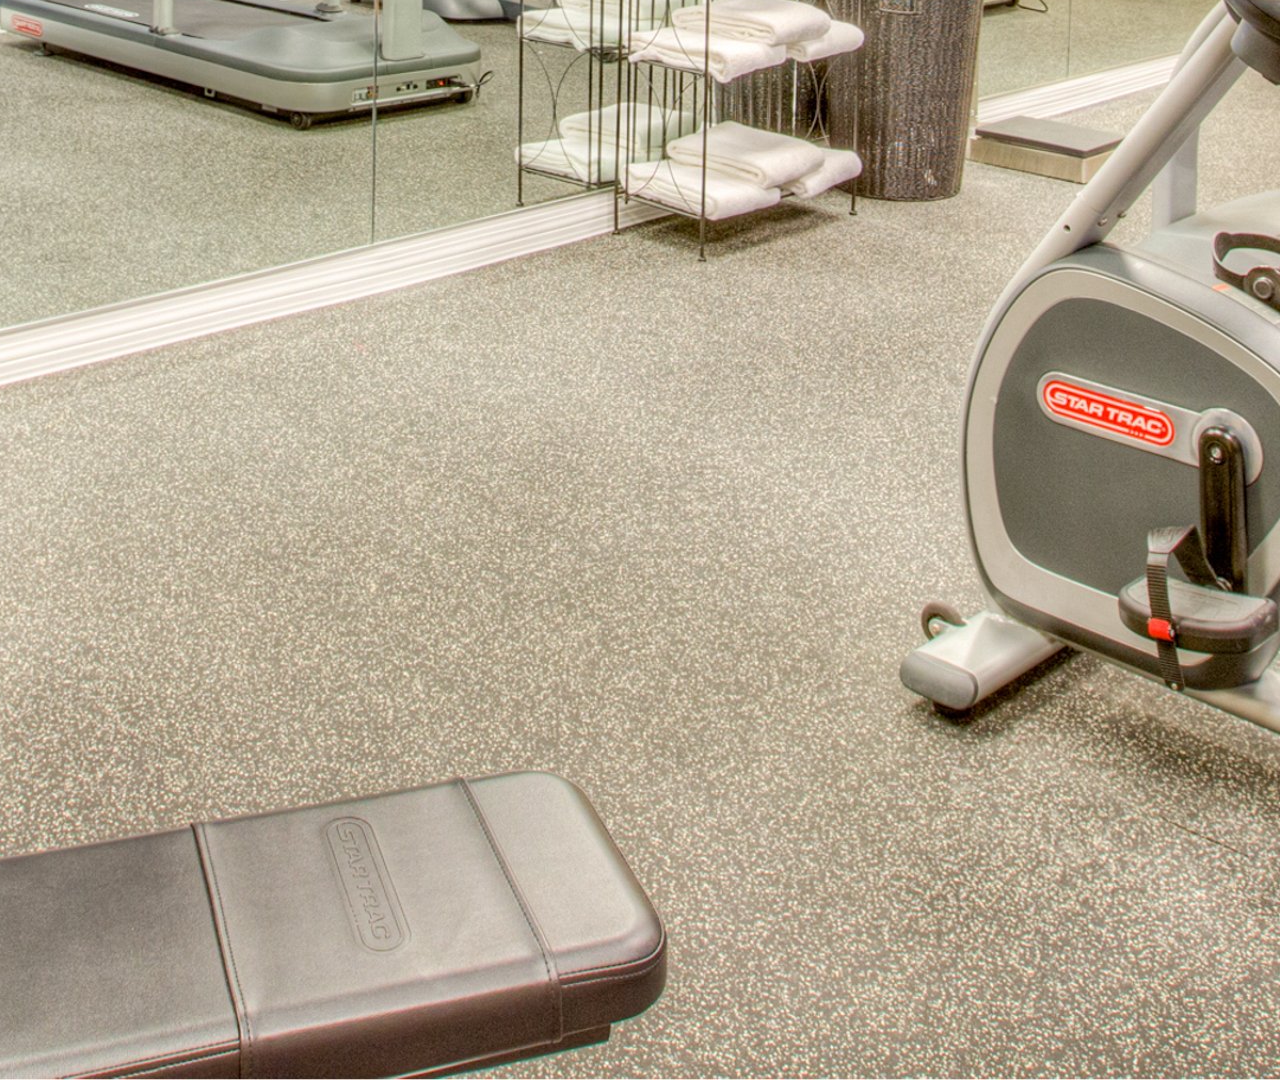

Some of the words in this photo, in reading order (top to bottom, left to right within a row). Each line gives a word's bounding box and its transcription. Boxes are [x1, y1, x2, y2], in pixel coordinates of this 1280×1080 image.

[1051, 391, 1104, 417] STAR
[1106, 407, 1163, 434] TRAC
[336, 822, 371, 878] STAR
[356, 880, 391, 940] TRAC
